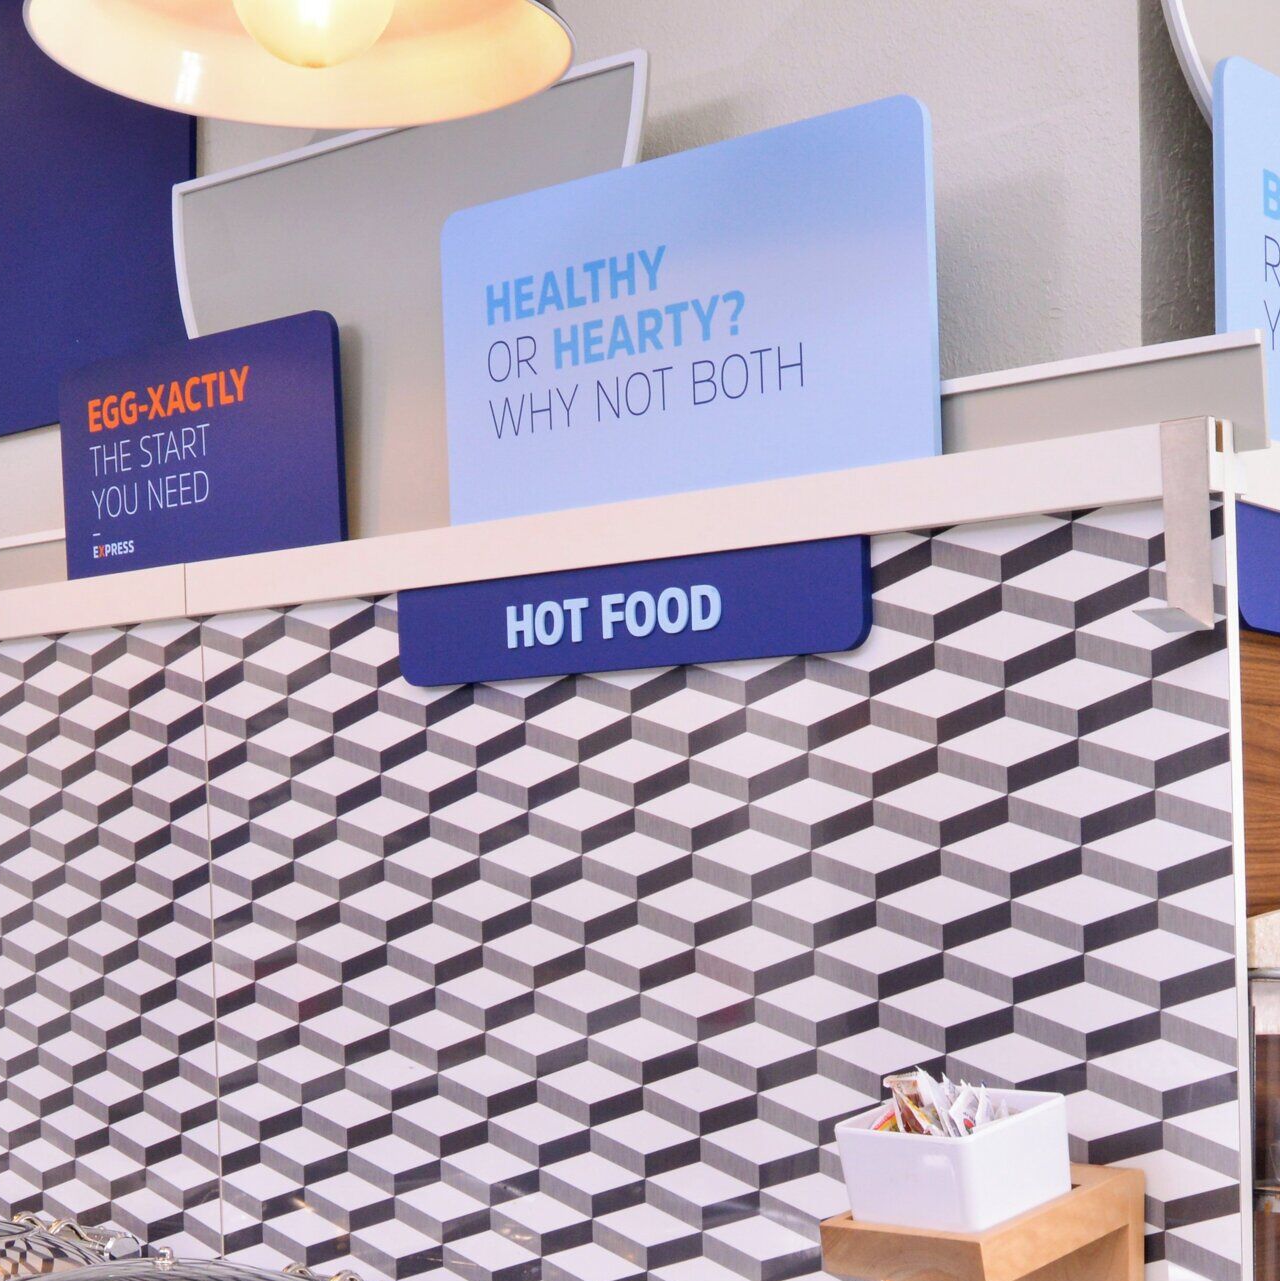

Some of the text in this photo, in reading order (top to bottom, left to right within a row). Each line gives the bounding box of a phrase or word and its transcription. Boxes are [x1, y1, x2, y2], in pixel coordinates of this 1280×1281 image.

[486, 245, 666, 326] HEALTHY
[487, 290, 746, 382] OR HEARTY?
[88, 365, 250, 433] EGG-XACTLY
[489, 342, 803, 439] WHY NOT BOTH
[89, 423, 210, 477] THE START
[91, 470, 209, 520] YOU NEED
[92, 540, 135, 558] EXPRESS
[506, 584, 721, 649] HOT FOOD
